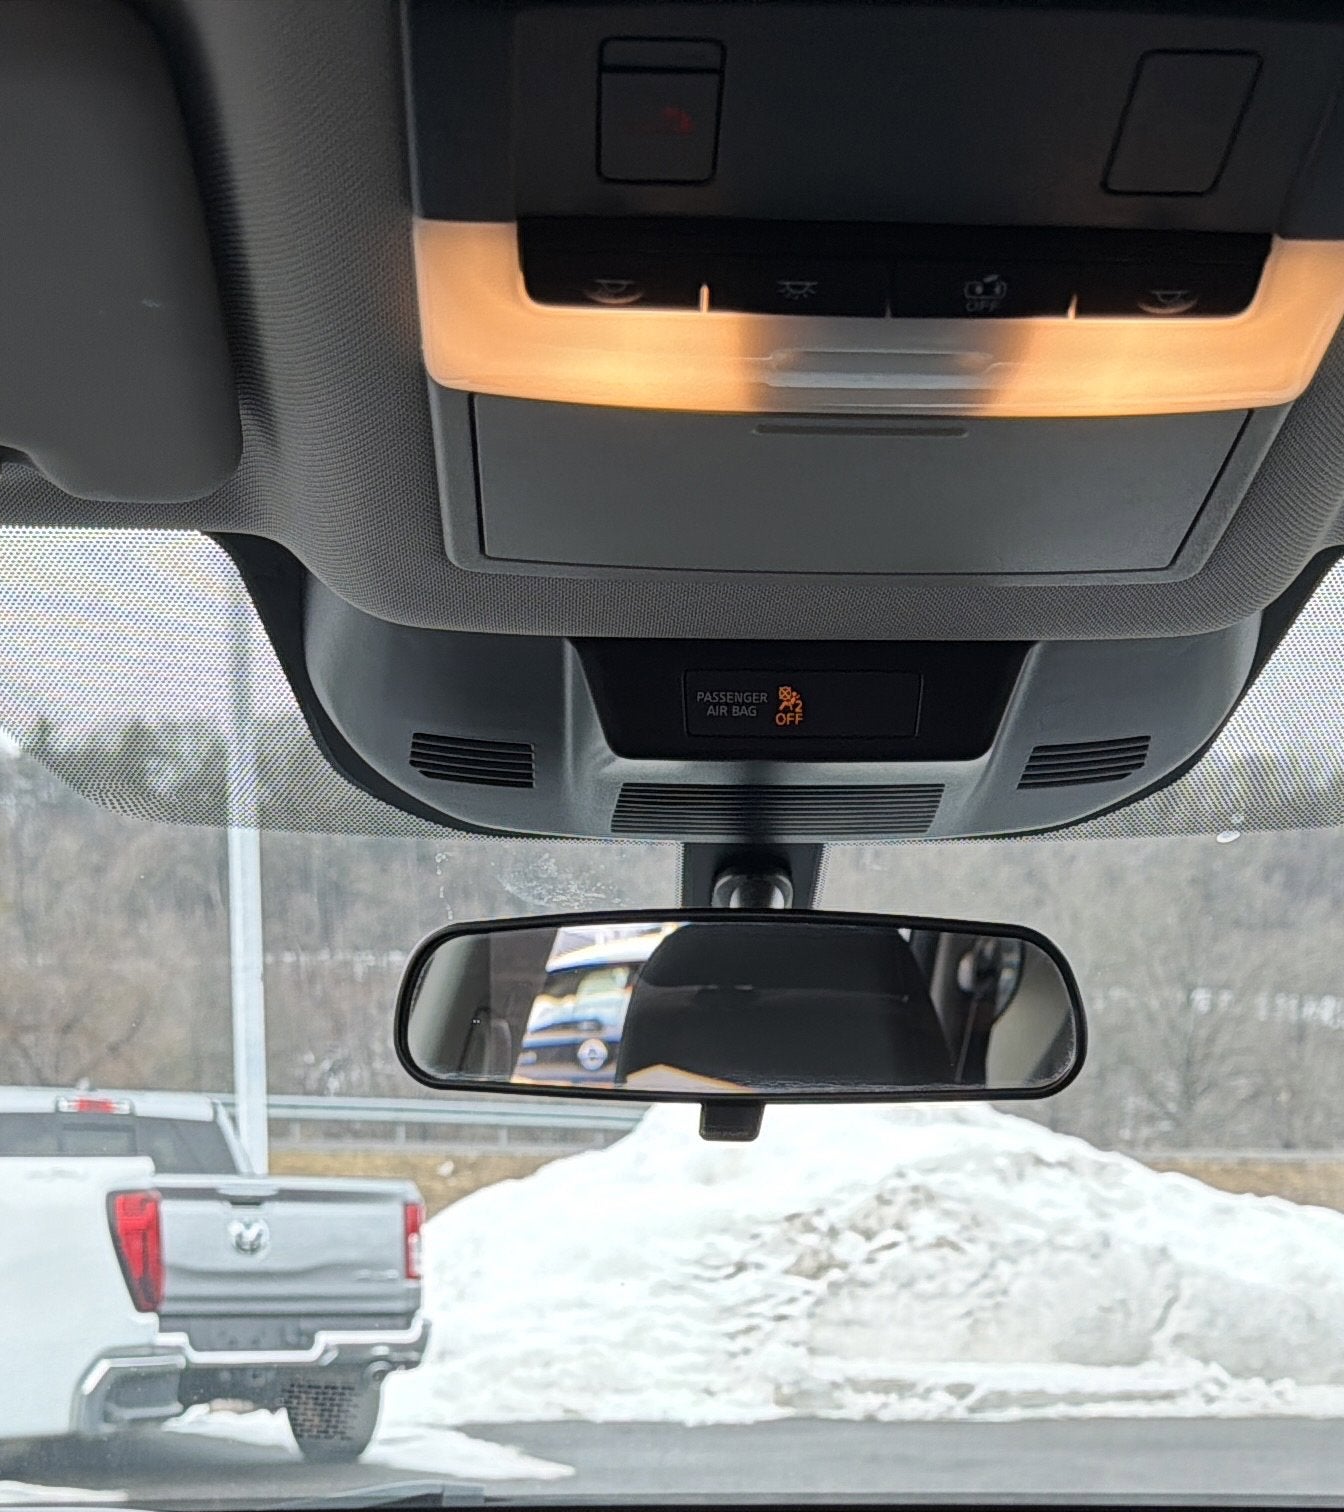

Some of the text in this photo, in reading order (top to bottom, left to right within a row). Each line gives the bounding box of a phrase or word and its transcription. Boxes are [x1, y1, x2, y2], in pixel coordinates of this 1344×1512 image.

[696, 691, 769, 704] PASSENGER
[707, 705, 757, 717] AIR BAG
[774, 713, 804, 726] OFF
